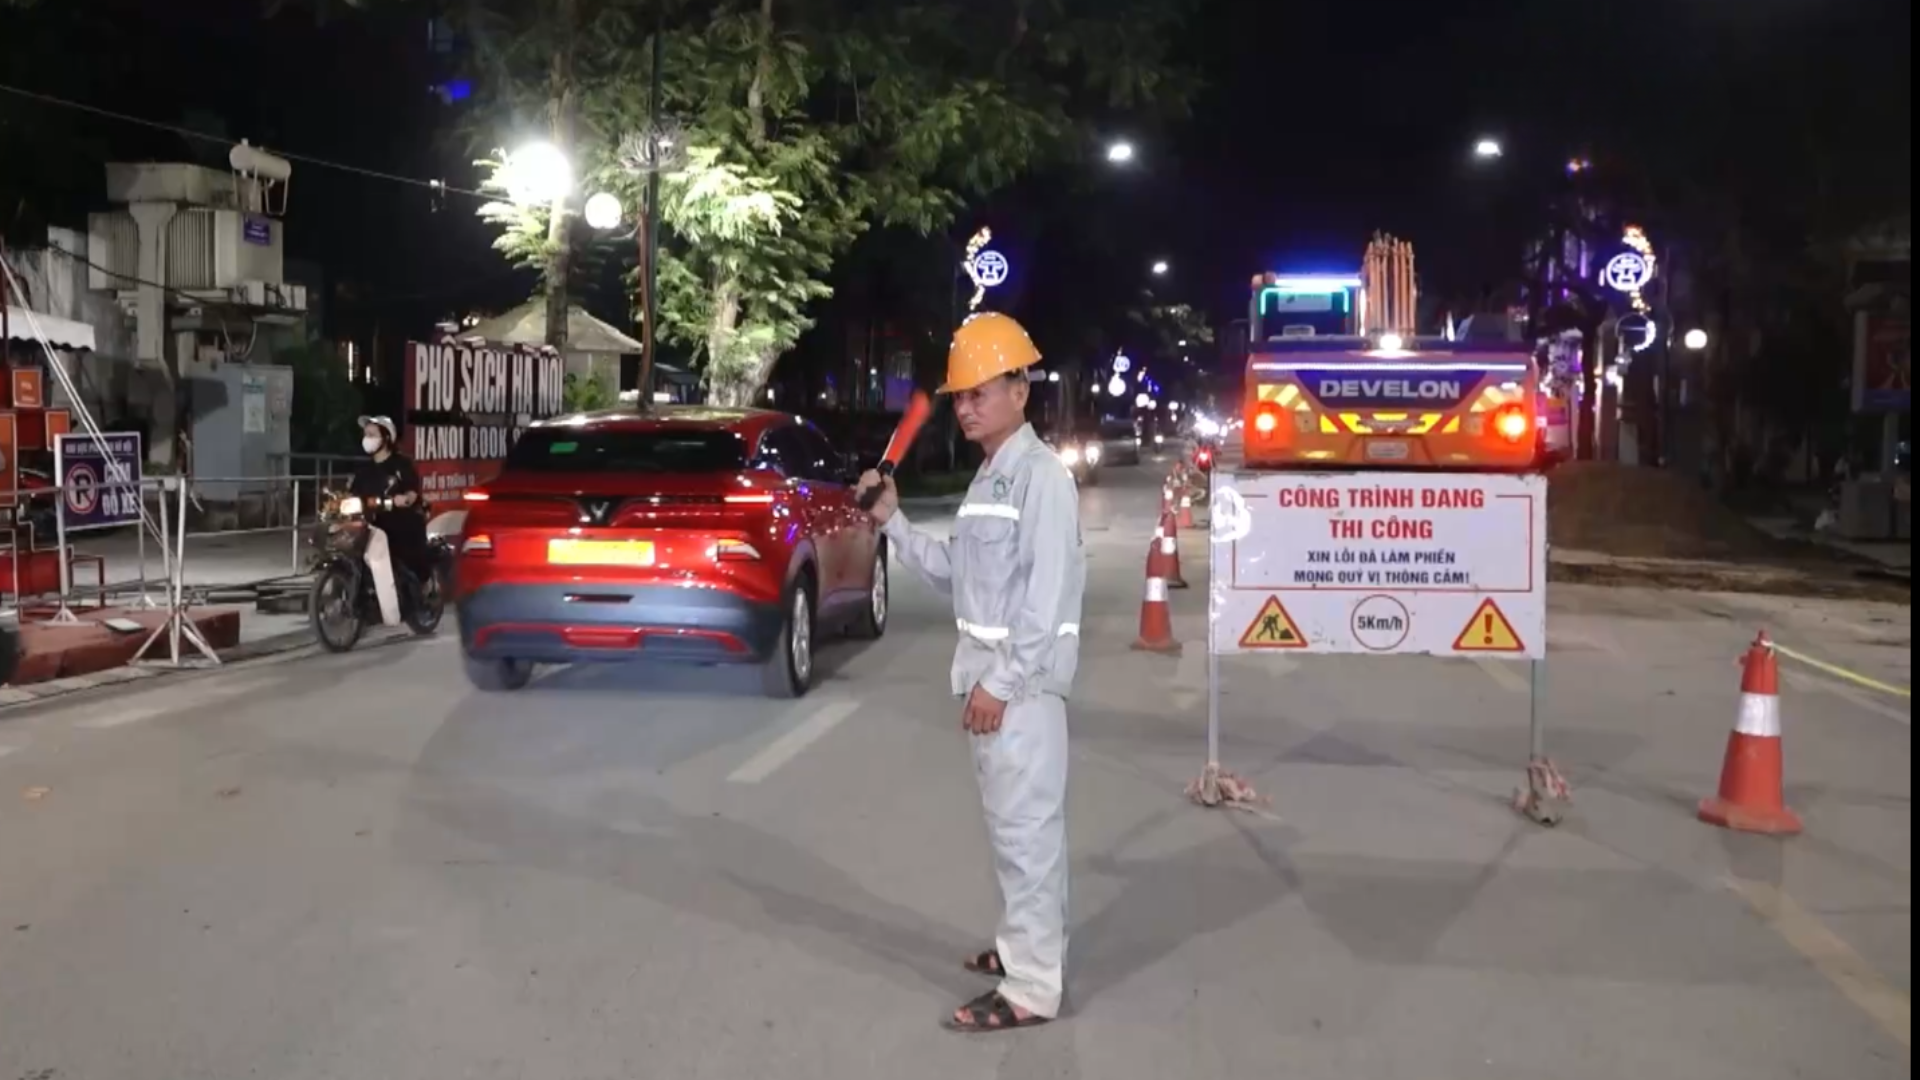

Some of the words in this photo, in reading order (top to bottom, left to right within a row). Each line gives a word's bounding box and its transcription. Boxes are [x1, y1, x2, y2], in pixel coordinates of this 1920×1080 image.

[460, 337, 508, 413] SÁCH
[511, 342, 534, 413] HÀ
[1319, 379, 1460, 399] DEVELON
[415, 425, 464, 460] HANOI
[469, 426, 508, 459] BOOK
[1279, 484, 1340, 509] CÔNG
[1347, 484, 1414, 509] TRÌNH
[1421, 488, 1484, 509] ĐANG
[1329, 519, 1363, 539] THI
[1371, 514, 1433, 539] CÔNG
[1307, 550, 1331, 563] XIN
[1294, 570, 1334, 583] MONG
[1338, 567, 1363, 584] QUÝ
[1368, 570, 1380, 586] VỊ
[1385, 568, 1429, 584] THÔNG
[1357, 615, 1403, 630] 5Km/h
